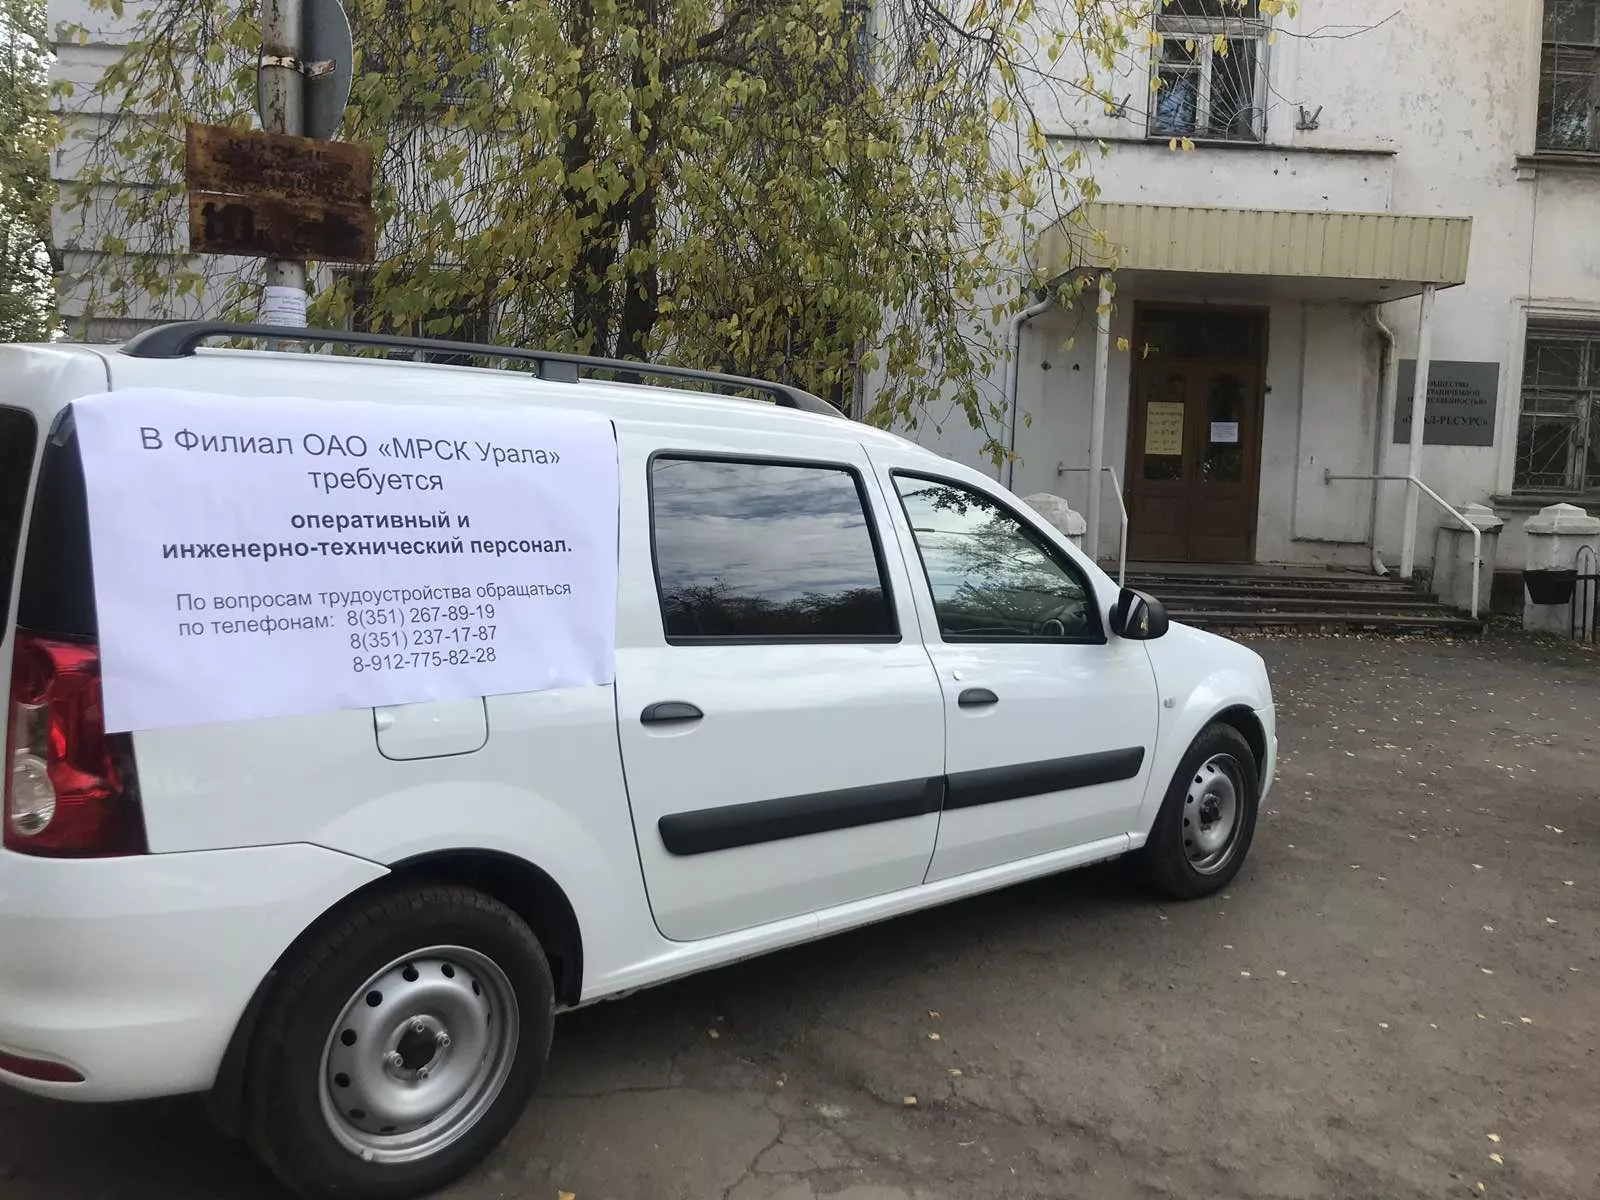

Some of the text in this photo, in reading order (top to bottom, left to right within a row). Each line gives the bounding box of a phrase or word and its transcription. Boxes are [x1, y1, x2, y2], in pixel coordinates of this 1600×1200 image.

[140, 427, 560, 467] В Филиал ОАО «МРСК Урала»
[308, 467, 443, 495] требуется
[291, 511, 470, 533] оперативный и
[163, 536, 571, 562] инженерно-технический персонал.
[177, 582, 571, 612] По вопросам трудоустройства обращаться
[179, 603, 494, 637] по телефонам: 8(351) 267-89-19
[351, 625, 496, 652] 8(351) 237-17-87
[353, 647, 496, 672] 8-912-775-82-28
